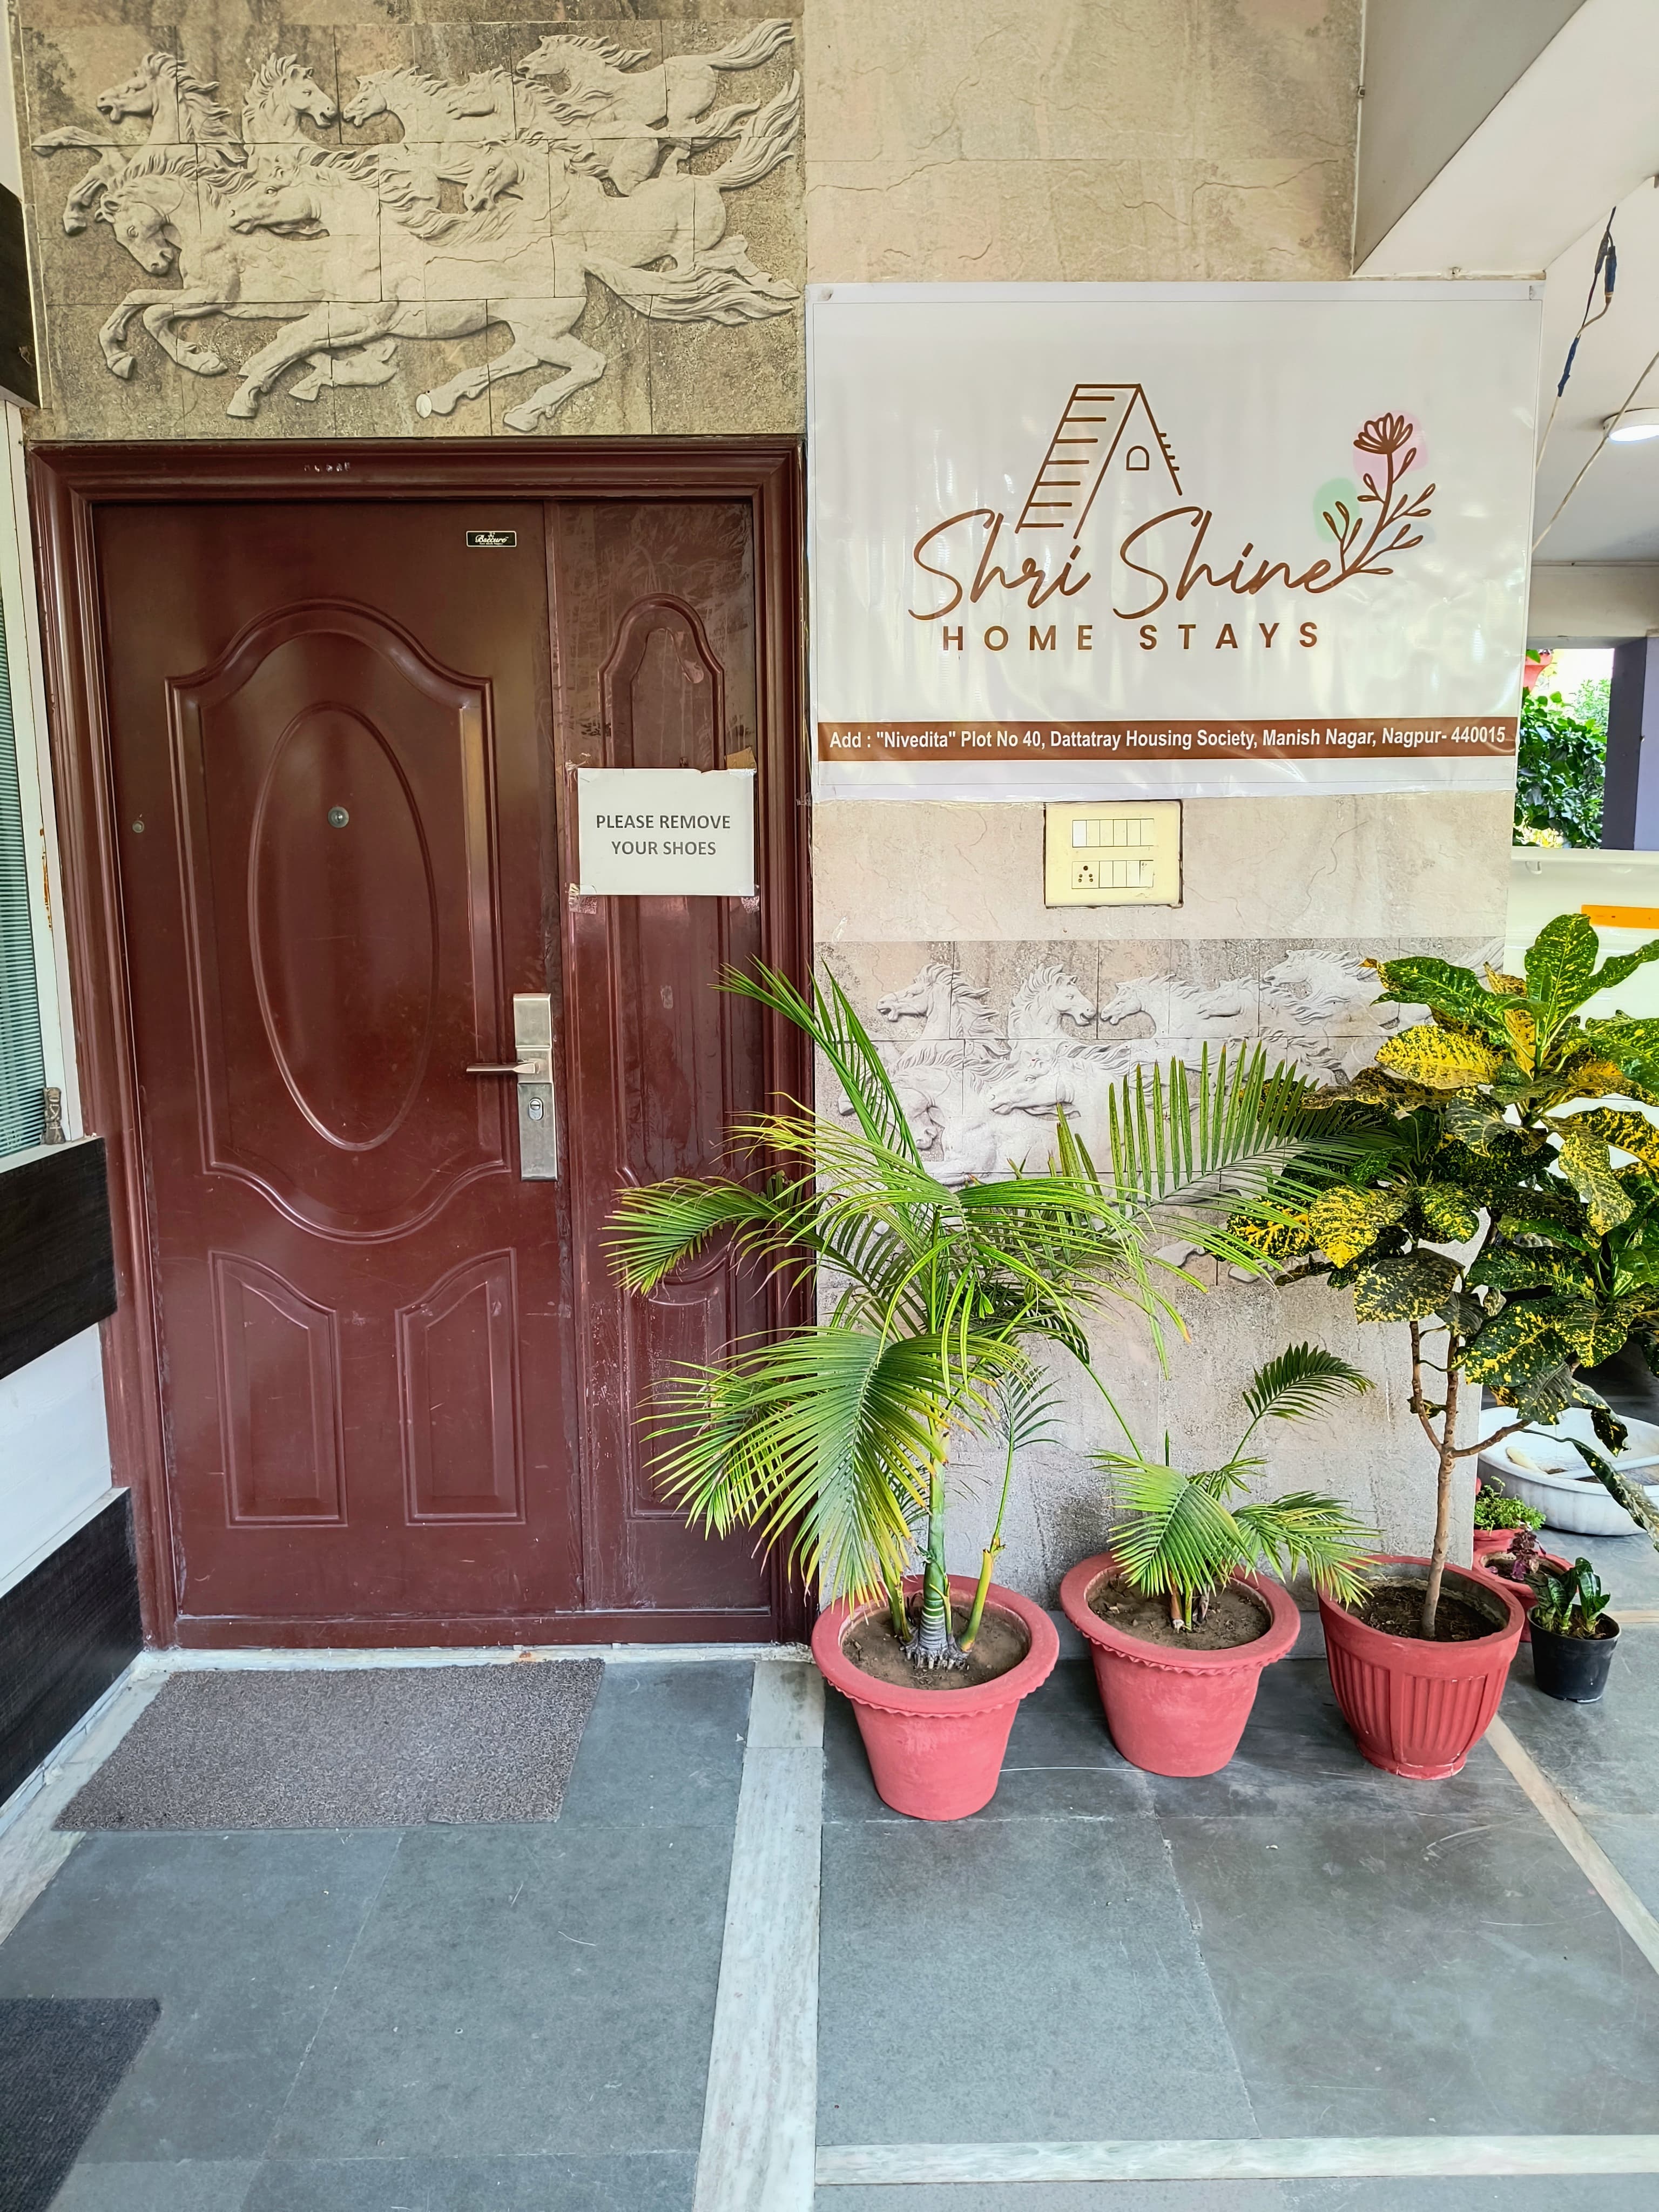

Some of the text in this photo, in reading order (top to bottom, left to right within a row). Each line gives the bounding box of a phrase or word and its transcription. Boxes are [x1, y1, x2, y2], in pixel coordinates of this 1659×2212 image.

[908, 506, 1338, 621] Shri Shine
[943, 622, 1319, 651] HOME STAYS
[830, 731, 862, 748] Add
[876, 731, 956, 748] "Nivedita"
[961, 731, 992, 747] Plot
[997, 730, 1018, 747] No
[1023, 730, 1046, 749] 40,
[1050, 730, 1121, 751] Dattatray
[1126, 730, 1192, 750] Housing
[1197, 729, 1258, 750] Society,
[1262, 729, 1320, 746] Manish
[1325, 728, 1375, 749] Nagar,
[1382, 727, 1447, 748] Nagpur-
[1451, 726, 1506, 743] 440015
[596, 815, 730, 829] PLEASE REMOVE
[611, 841, 716, 855] YOUR SHOES
